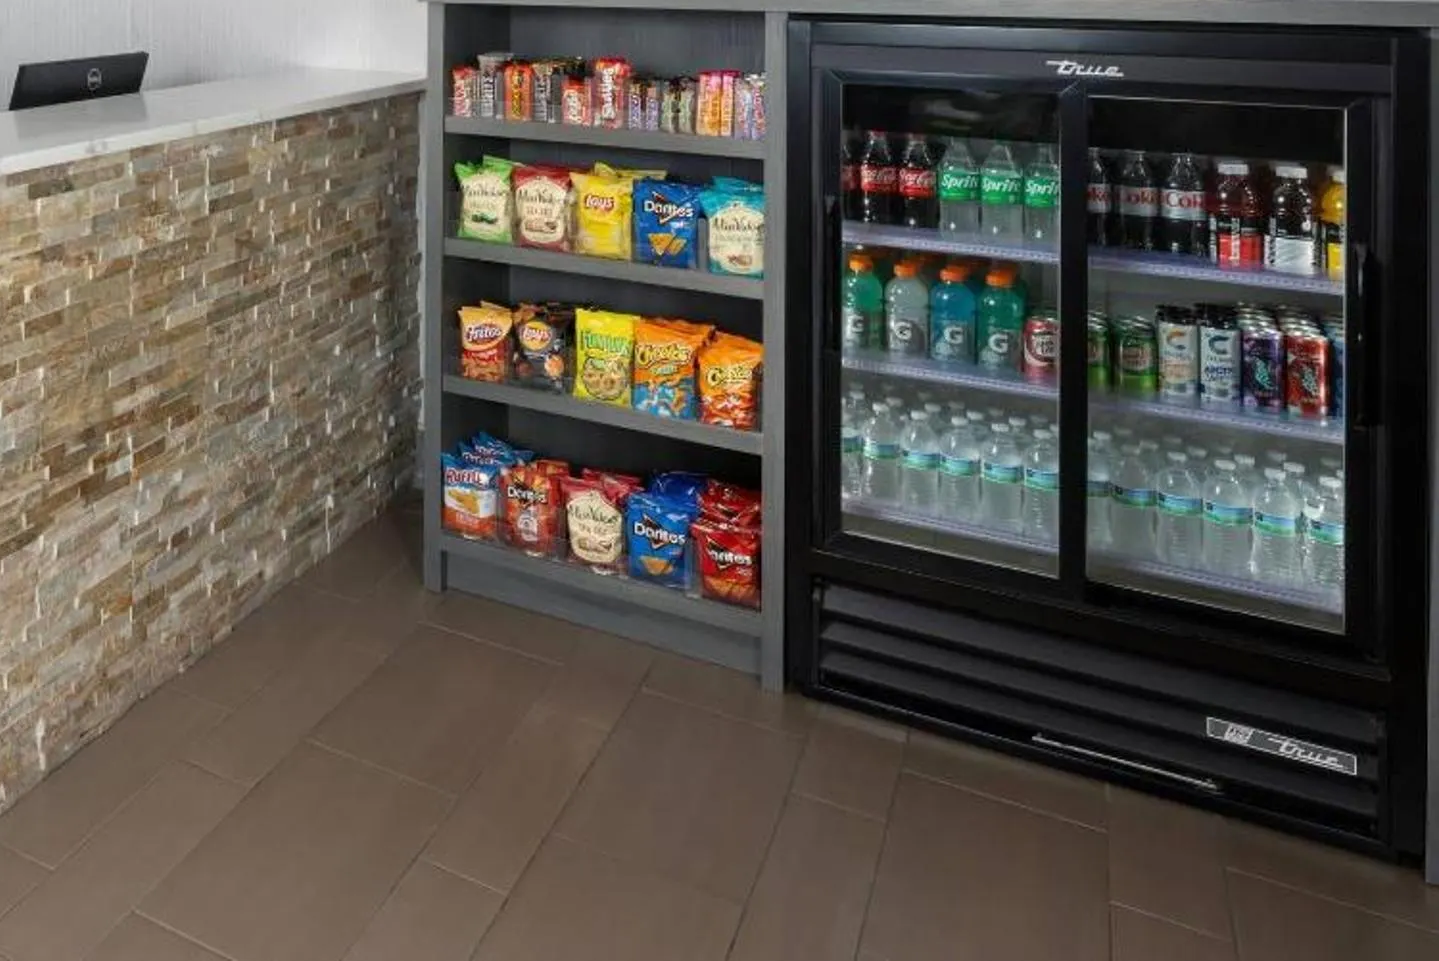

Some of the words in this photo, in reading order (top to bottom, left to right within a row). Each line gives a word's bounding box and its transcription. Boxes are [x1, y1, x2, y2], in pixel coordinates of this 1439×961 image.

[643, 200, 694, 218] Doritos
[944, 326, 963, 344] G
[989, 333, 1009, 354] G
[634, 522, 686, 545] Doritos
